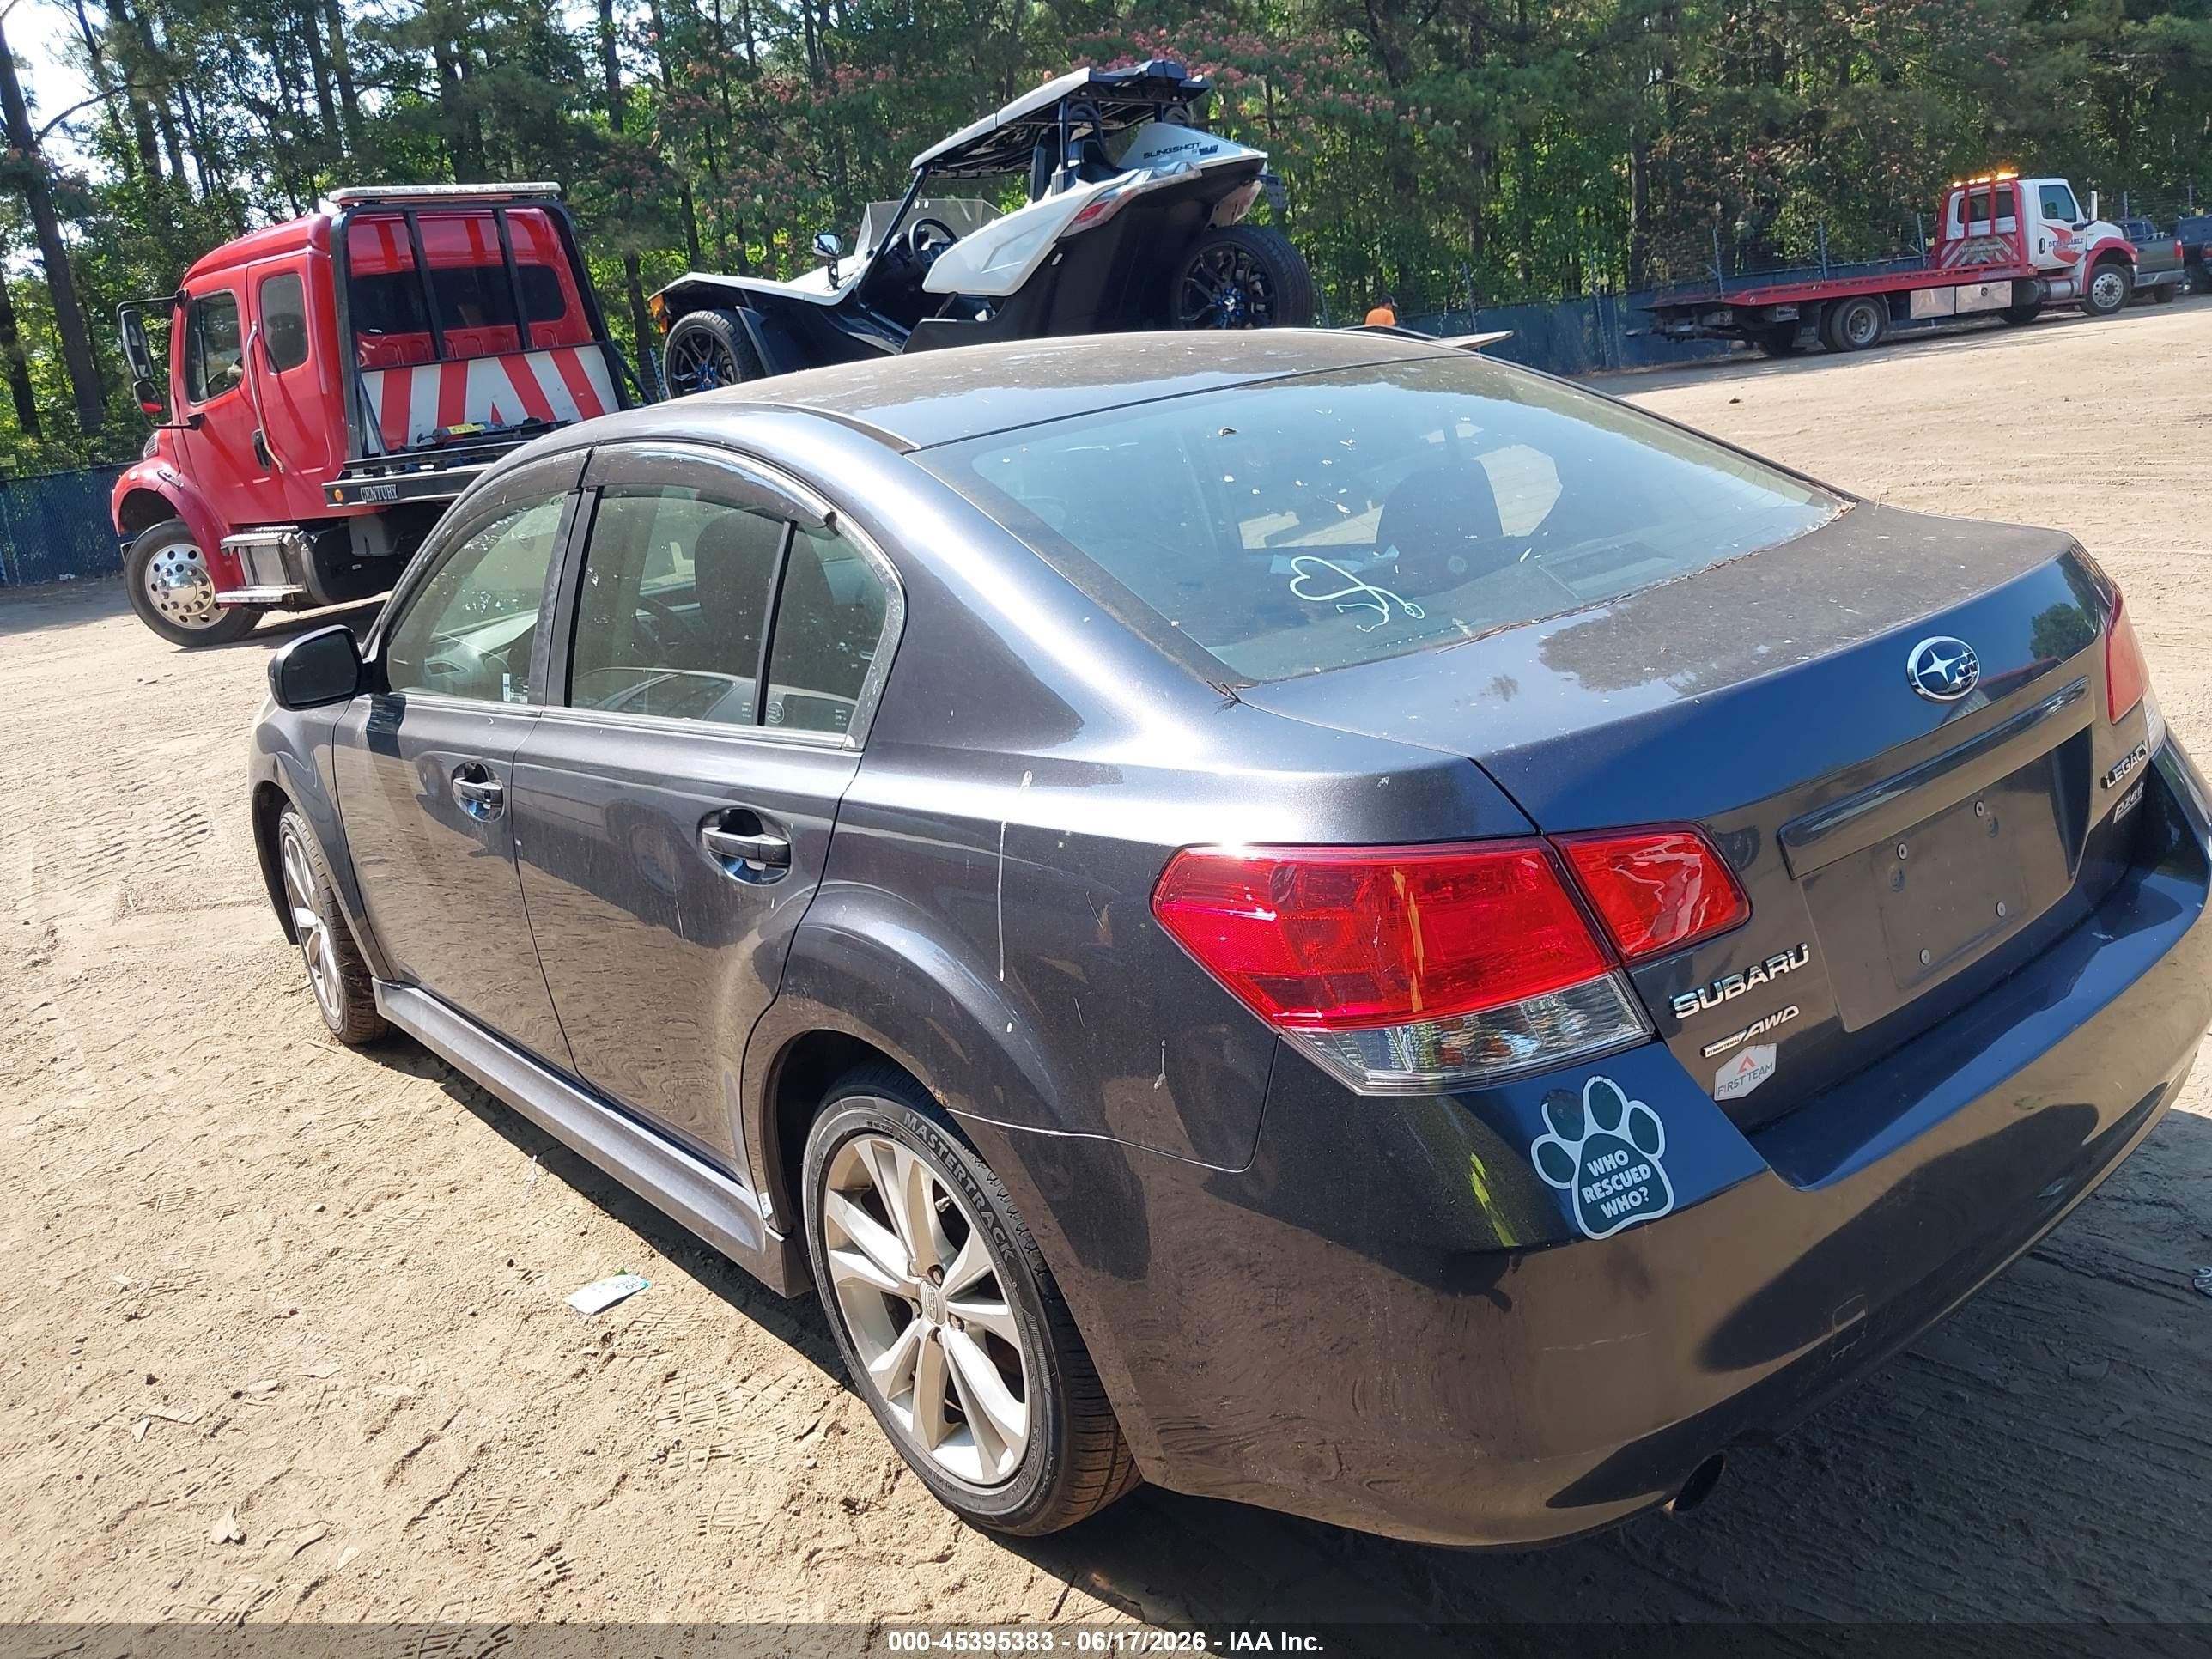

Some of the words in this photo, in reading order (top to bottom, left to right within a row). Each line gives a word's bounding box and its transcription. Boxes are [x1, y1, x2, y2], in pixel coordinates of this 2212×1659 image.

[1143, 142, 1202, 159] SLINGSHOT
[360, 483, 398, 501] CENTURY
[1672, 943, 1810, 1019] SUBARU
[1742, 1005, 1800, 1042] AWD
[1717, 1073, 1747, 1097] FIRST
[1746, 1062, 1774, 1080] TEAM
[1586, 1149, 1629, 1177] WHO
[903, 1111, 1017, 1263] MASTERTRACK
[1581, 1163, 1652, 1204] RESCUED
[1600, 1186, 1650, 1218] WHO?
